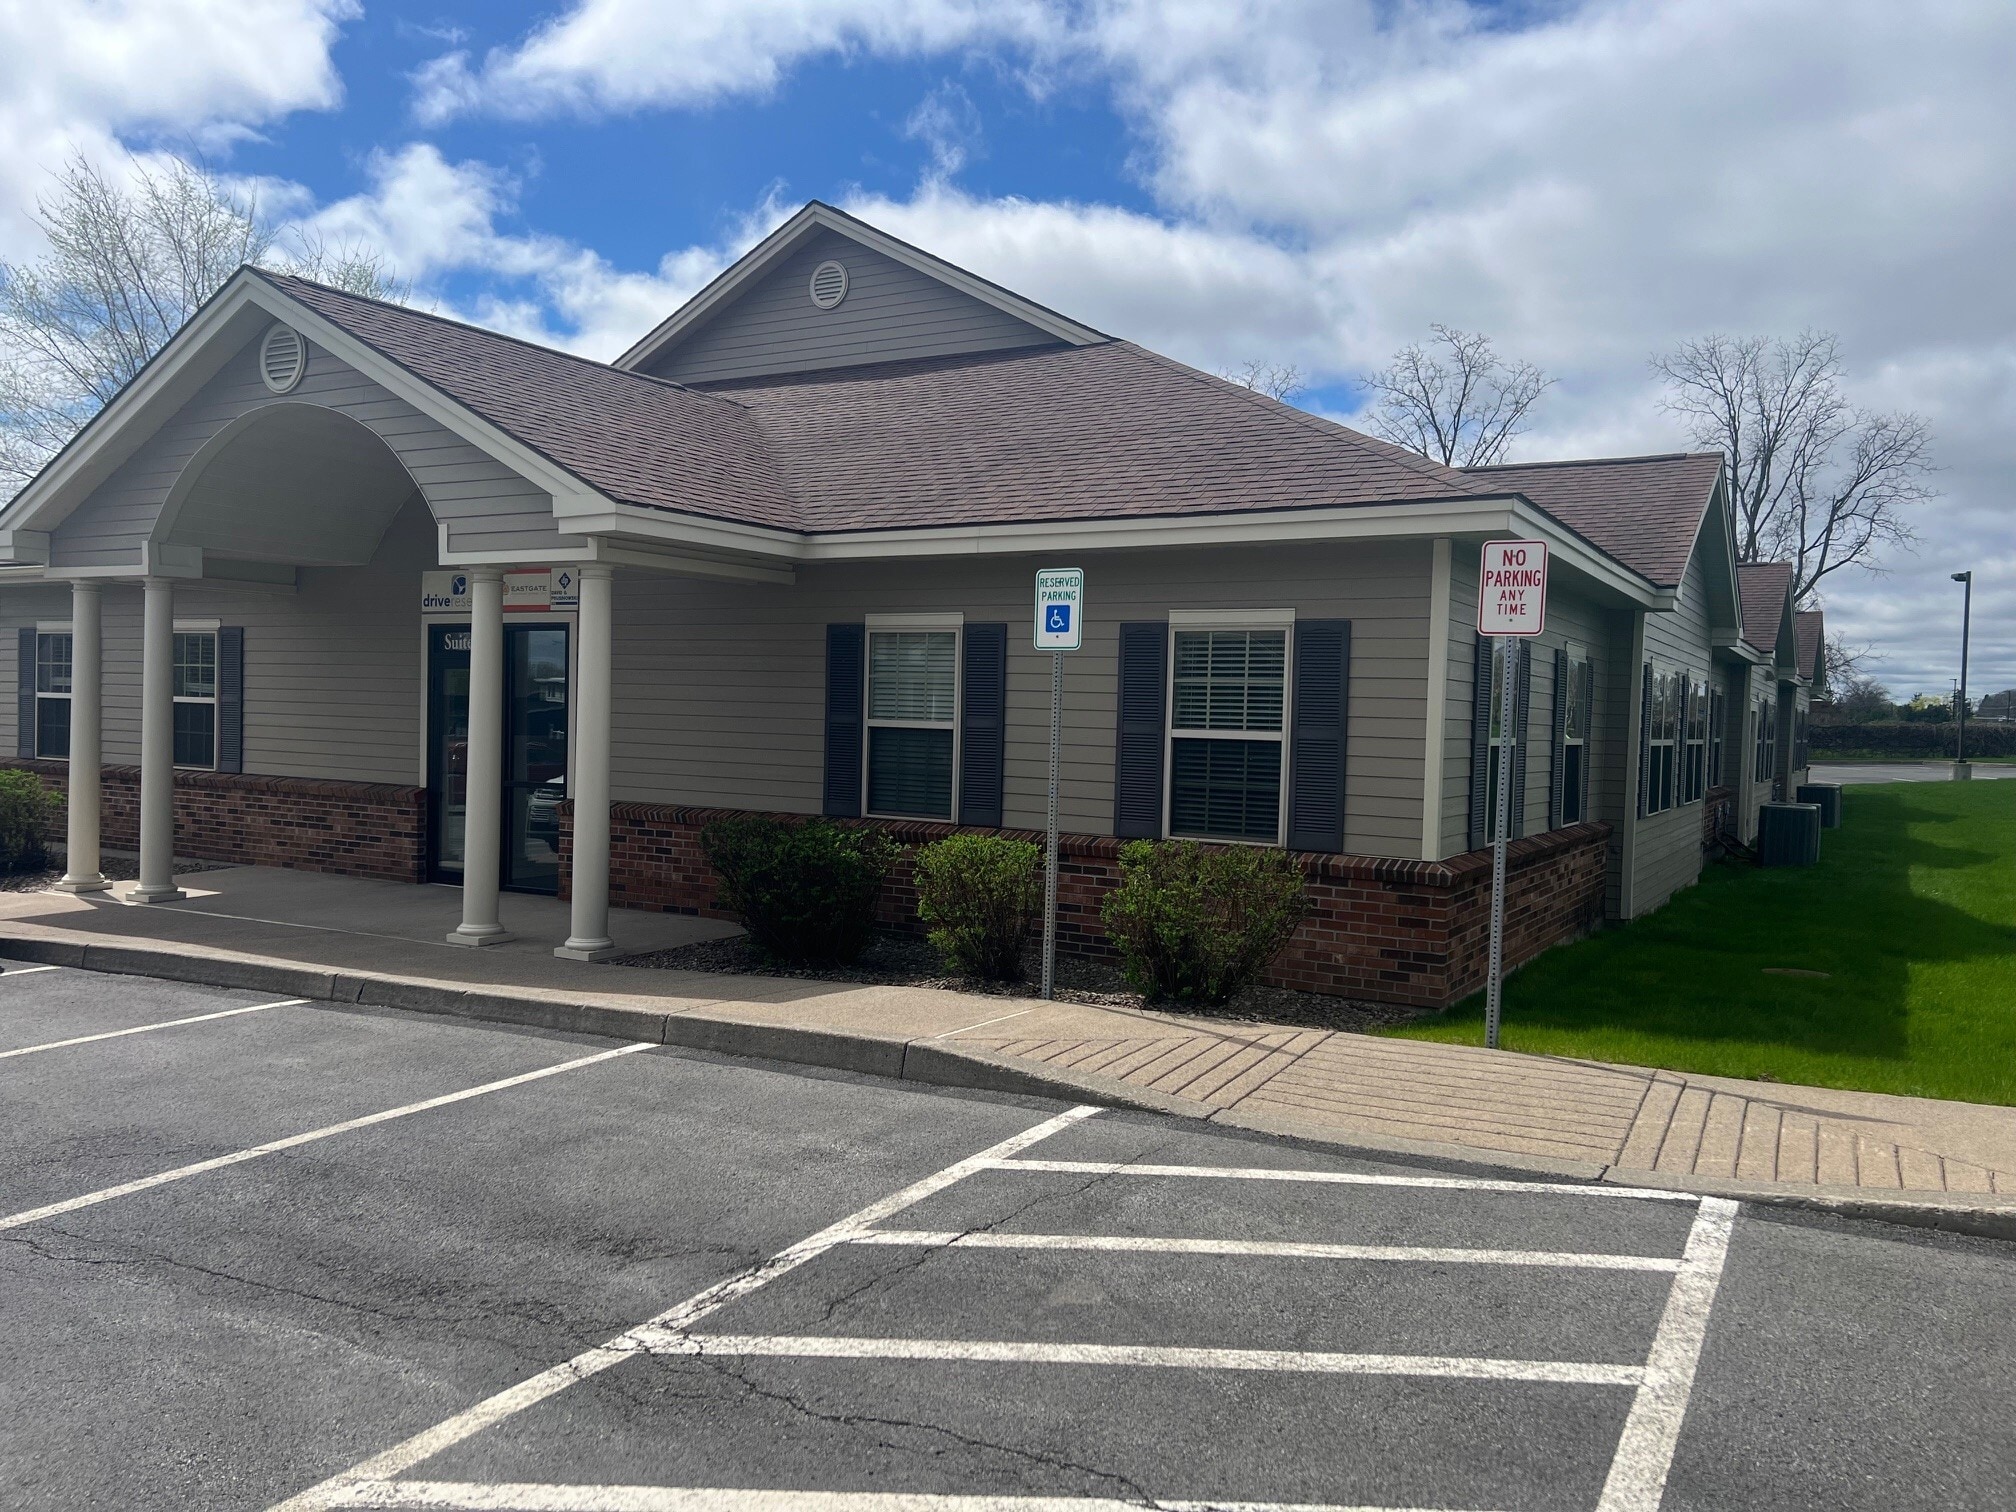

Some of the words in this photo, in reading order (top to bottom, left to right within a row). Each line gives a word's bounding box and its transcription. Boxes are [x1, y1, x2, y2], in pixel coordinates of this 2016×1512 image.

[1503, 549, 1526, 567] NO
[1040, 577, 1080, 588] RESERVED
[1485, 570, 1541, 587] PARKING
[1042, 591, 1076, 601] PARKING
[1499, 589, 1525, 601] ANY
[1497, 603, 1527, 616] TIME
